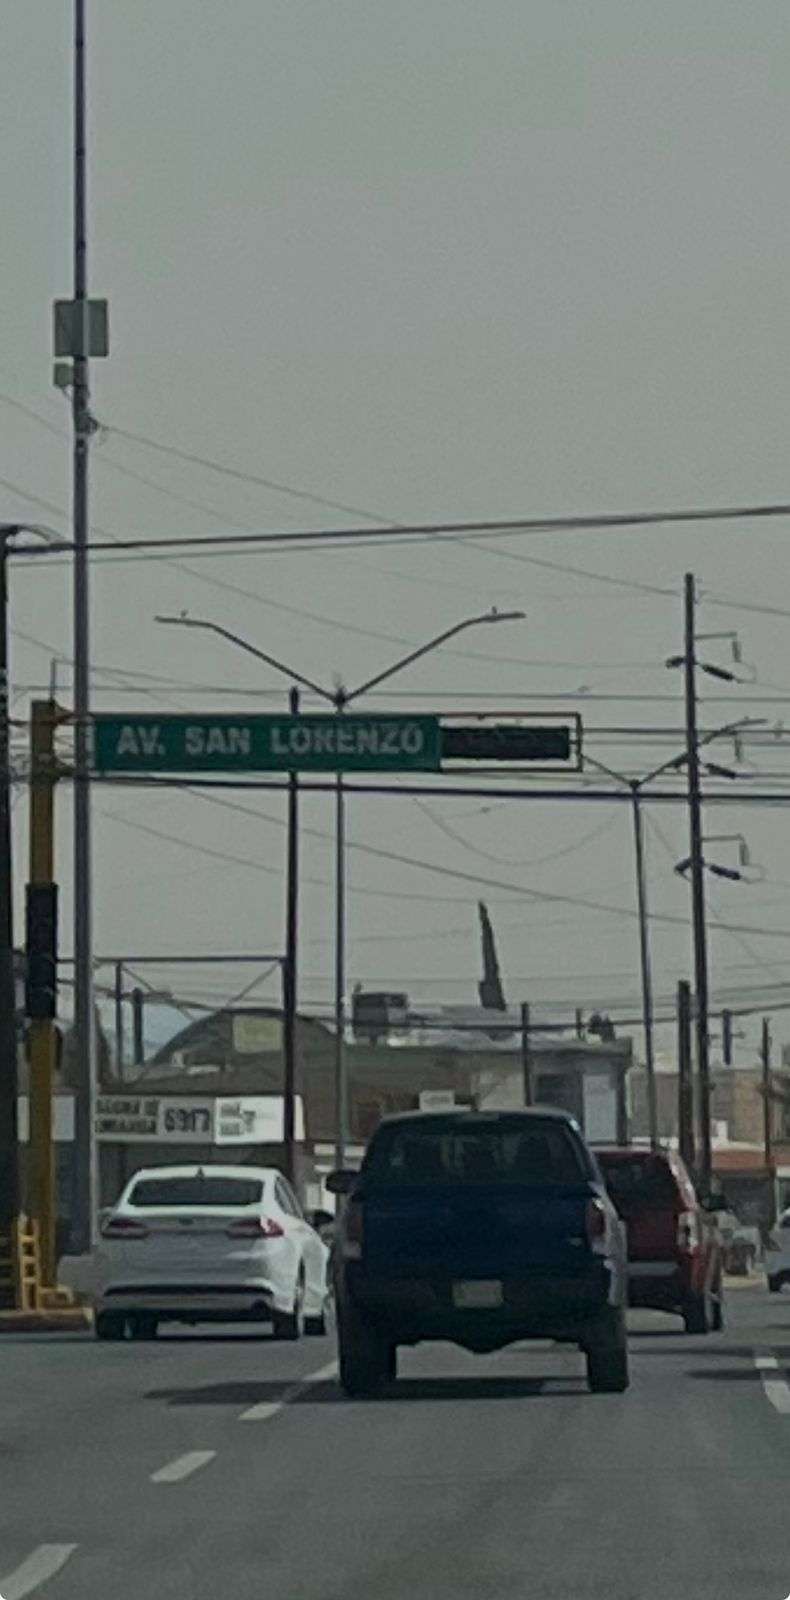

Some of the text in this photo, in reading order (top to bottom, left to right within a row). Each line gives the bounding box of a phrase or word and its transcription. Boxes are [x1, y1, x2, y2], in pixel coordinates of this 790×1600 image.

[117, 725, 424, 756] AV. SAN LORENZO
